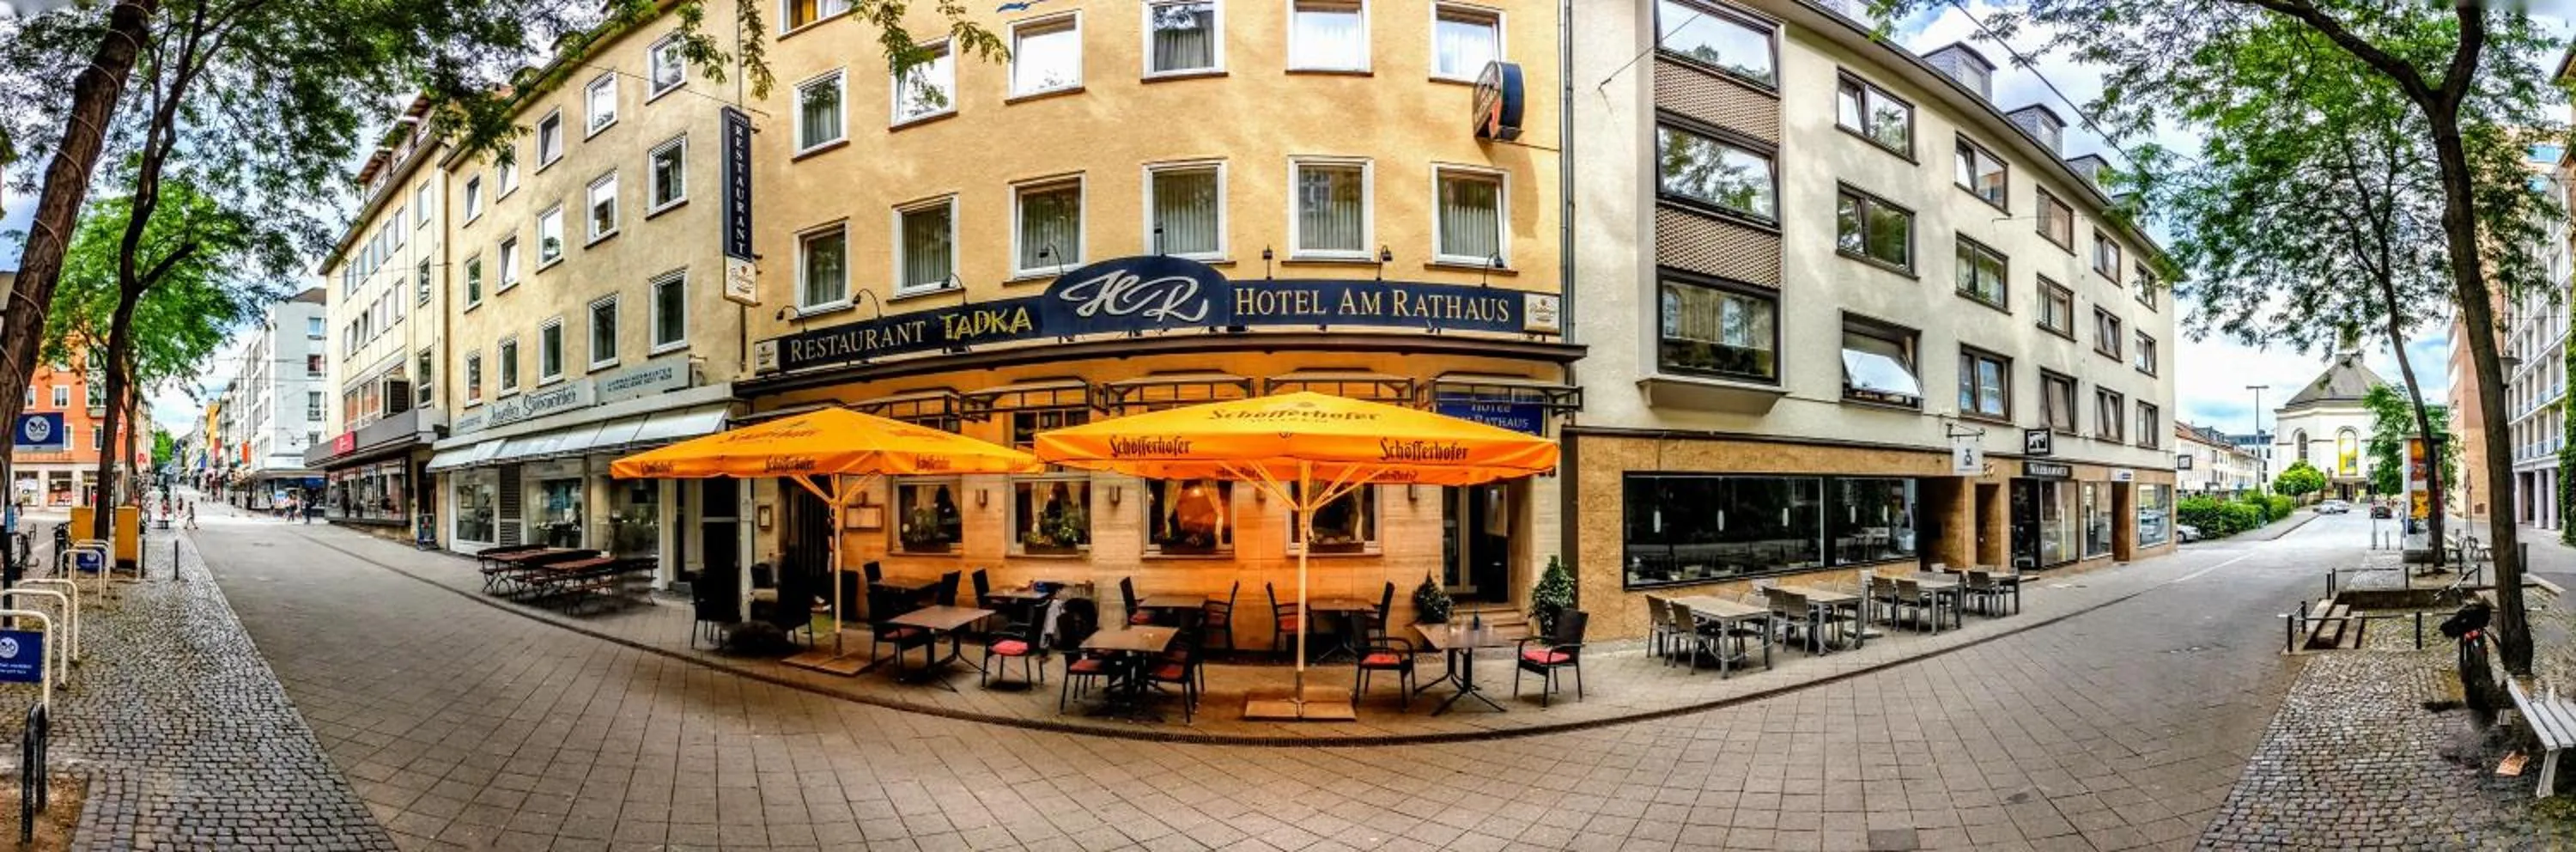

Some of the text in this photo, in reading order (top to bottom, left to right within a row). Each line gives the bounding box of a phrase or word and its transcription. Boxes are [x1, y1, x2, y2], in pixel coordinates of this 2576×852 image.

[736, 125, 745, 254] RESTAURANT
[1234, 288, 1327, 316] HOTEL
[1338, 288, 1382, 316] AM
[1393, 289, 1510, 323] RATHAUS
[791, 320, 927, 362] RESTAURANT
[939, 307, 1033, 340] TADKA
[1379, 436, 1469, 461] Schöfferhofer
